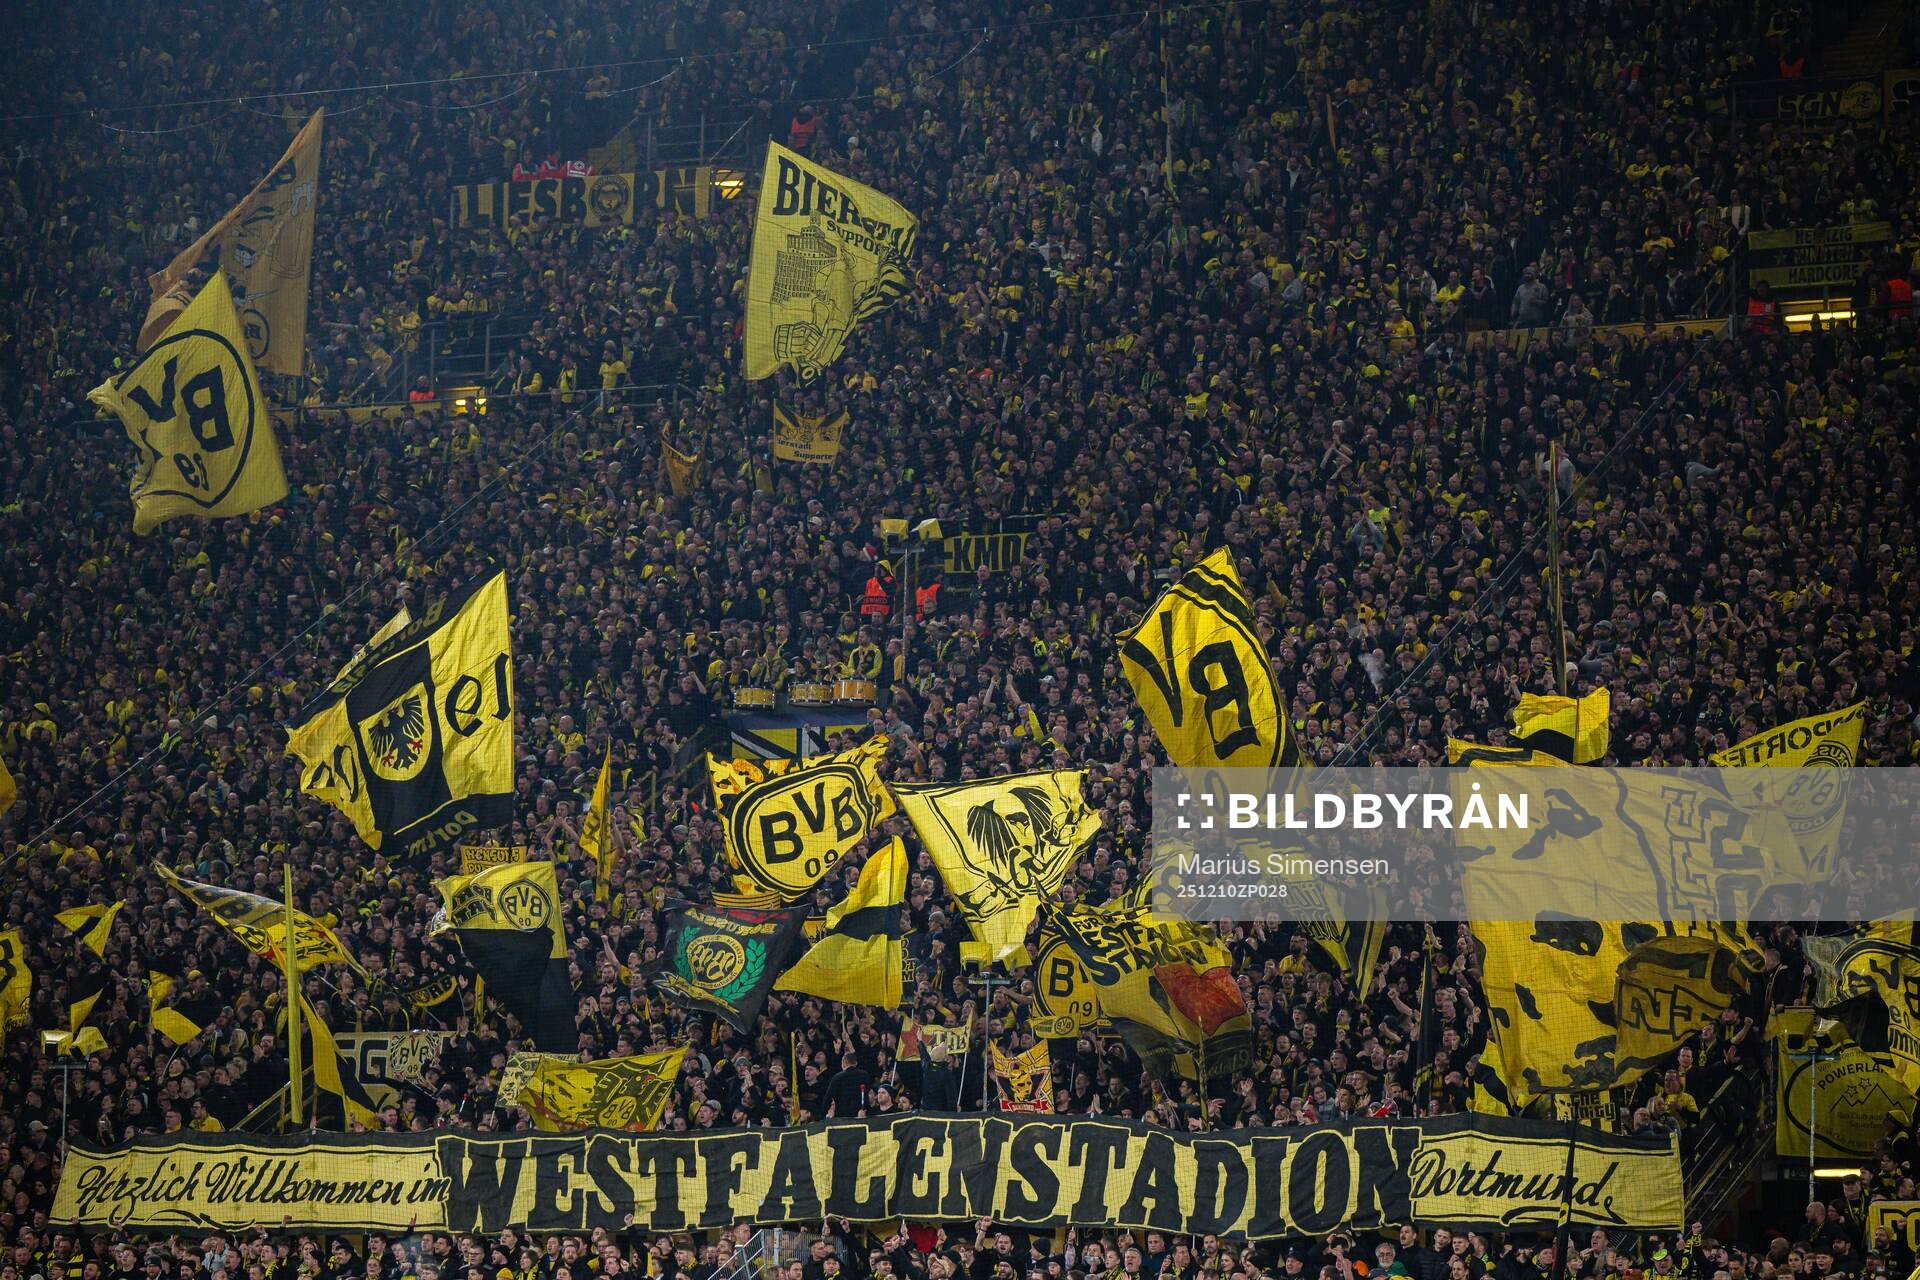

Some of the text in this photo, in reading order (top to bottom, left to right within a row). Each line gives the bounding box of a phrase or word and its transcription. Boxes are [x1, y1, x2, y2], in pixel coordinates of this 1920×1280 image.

[759, 782, 864, 865] BVB
[803, 849, 840, 879] 09
[1816, 1063, 1889, 1091] POWERLA
[75, 1117, 1620, 1240] Herzlich Willkommen im WESTFALENSTADION Dortmund
